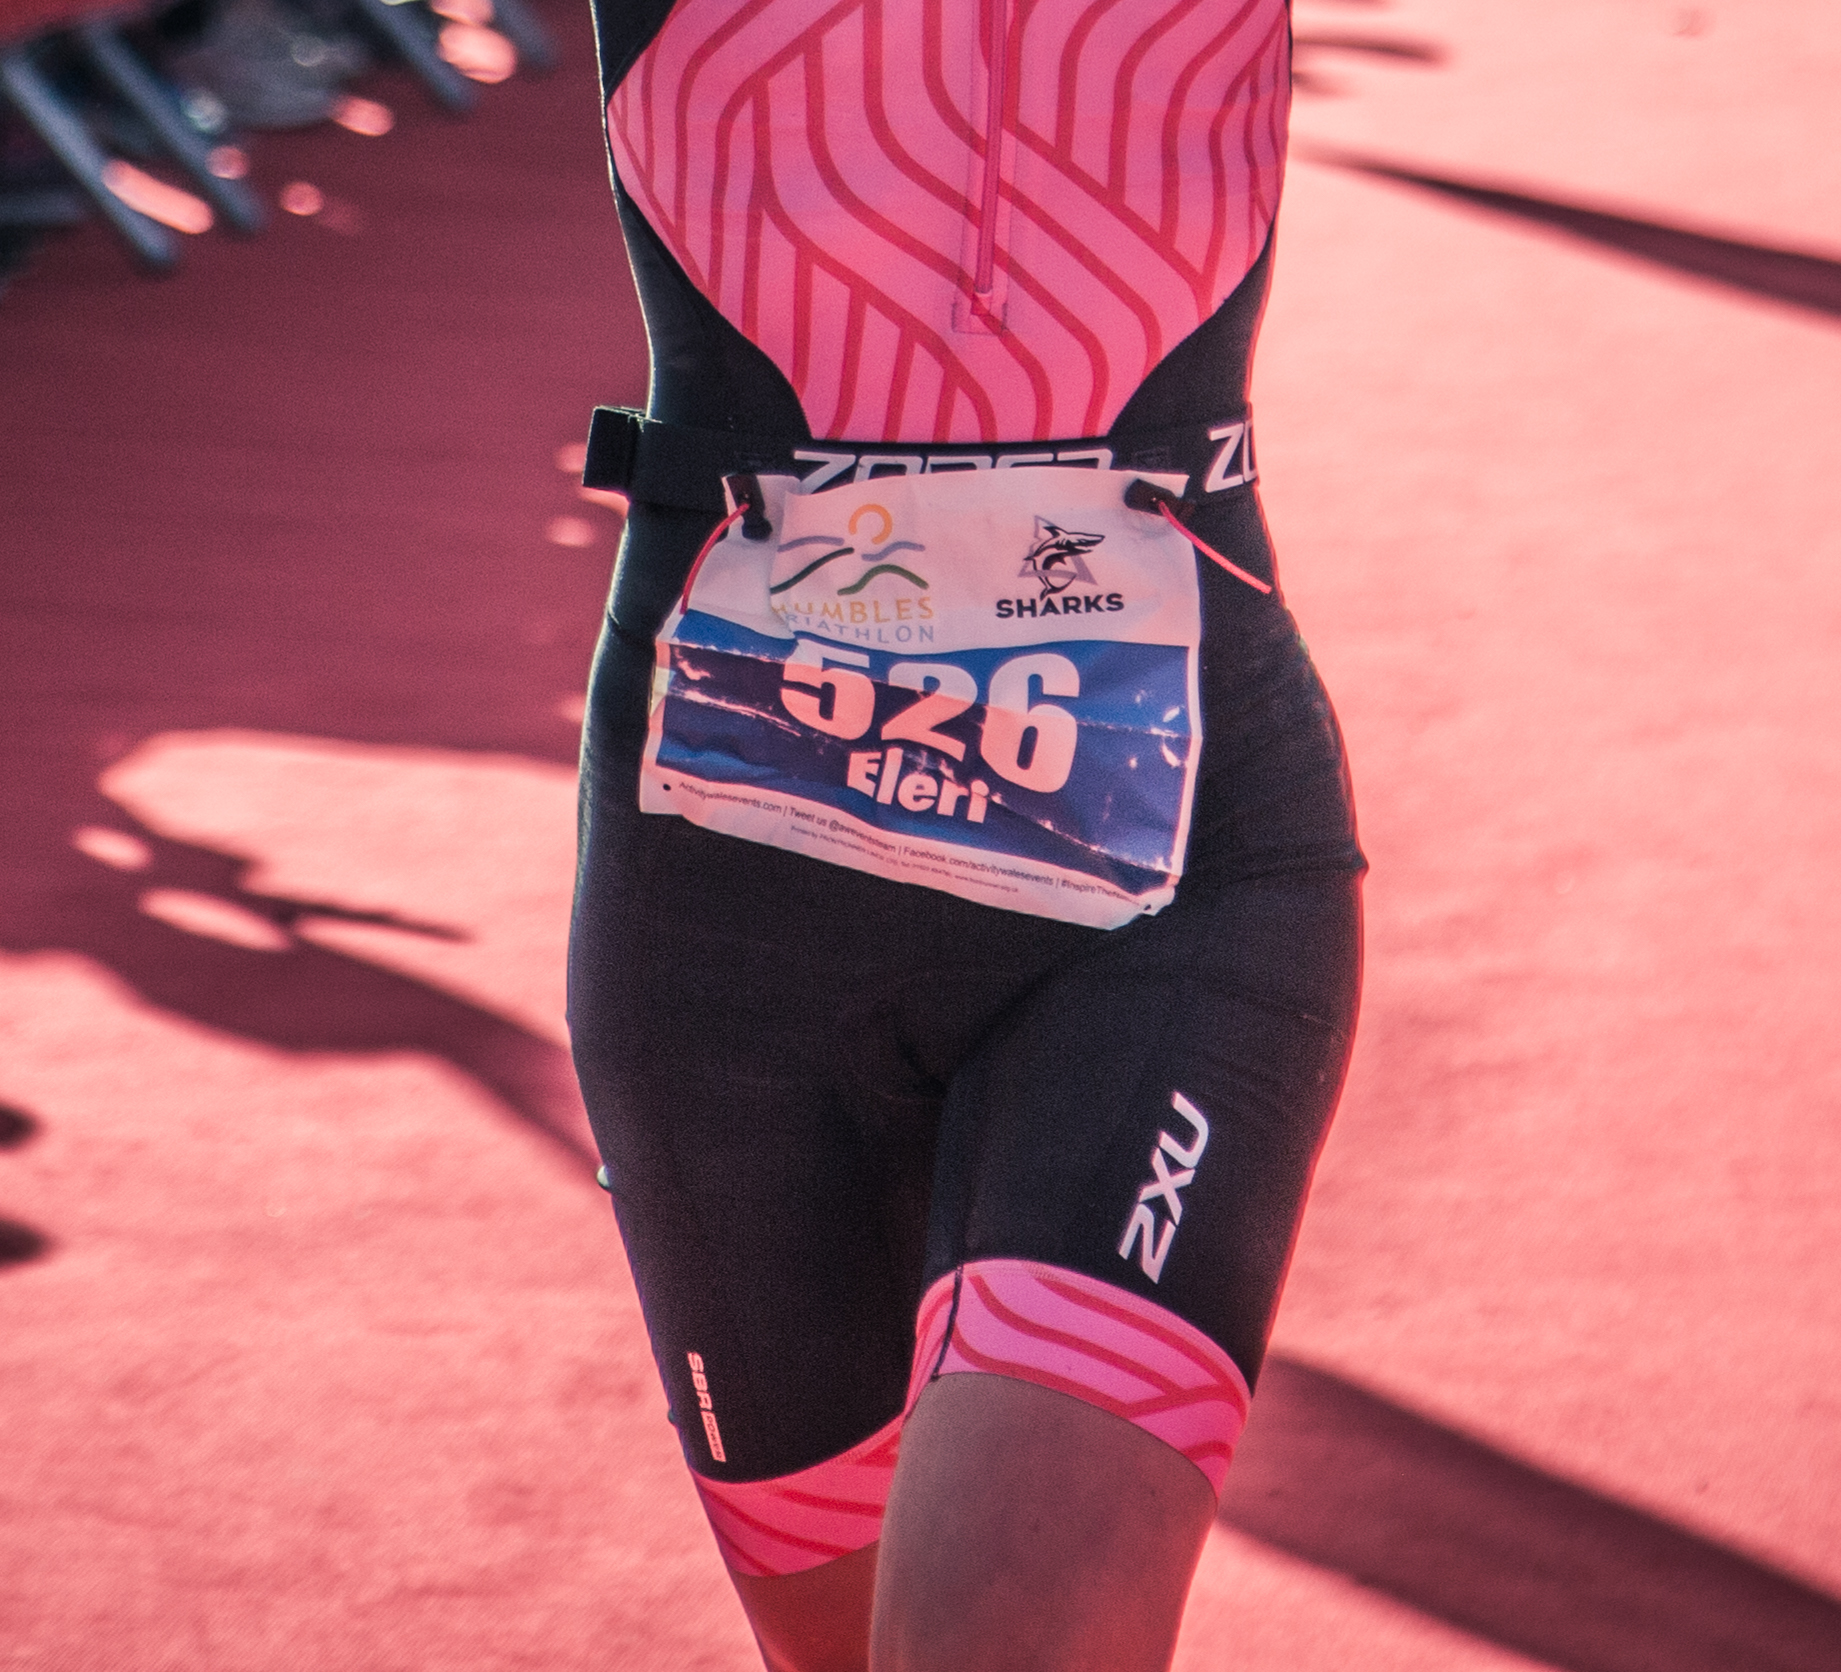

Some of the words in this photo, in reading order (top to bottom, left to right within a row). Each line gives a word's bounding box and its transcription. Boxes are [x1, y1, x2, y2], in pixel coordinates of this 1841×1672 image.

[996, 592, 1125, 619] SHARKS
[780, 638, 1080, 793] 526
[847, 746, 990, 824] Eleri
[789, 807, 815, 823] Tweet
[816, 816, 828, 827] us
[687, 1351, 712, 1411] SBR
